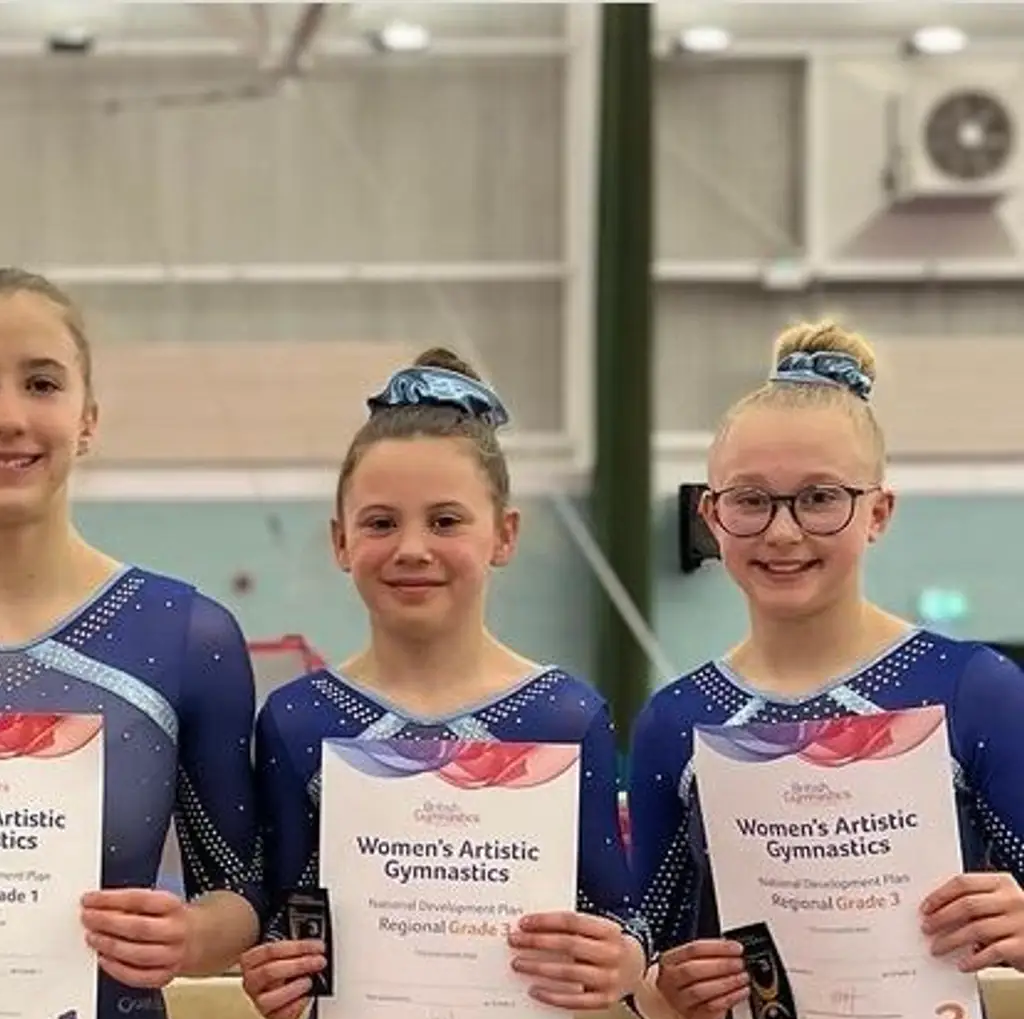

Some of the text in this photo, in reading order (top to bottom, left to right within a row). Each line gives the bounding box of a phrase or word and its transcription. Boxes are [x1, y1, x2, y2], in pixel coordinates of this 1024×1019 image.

[736, 809, 918, 837] Women's Artistic
[356, 836, 540, 861] Women's Artistic
[766, 836, 891, 863] Gymnastics
[27, 870, 51, 882] Plan
[384, 860, 509, 884] Gymnastics
[803, 877, 880, 890] Development
[883, 873, 911, 885] Plan
[32, 890, 39, 902] 1
[771, 892, 900, 911] Regional Grade 3
[368, 898, 523, 915] National Development Plan
[378, 917, 510, 937] Regional Grade 3
